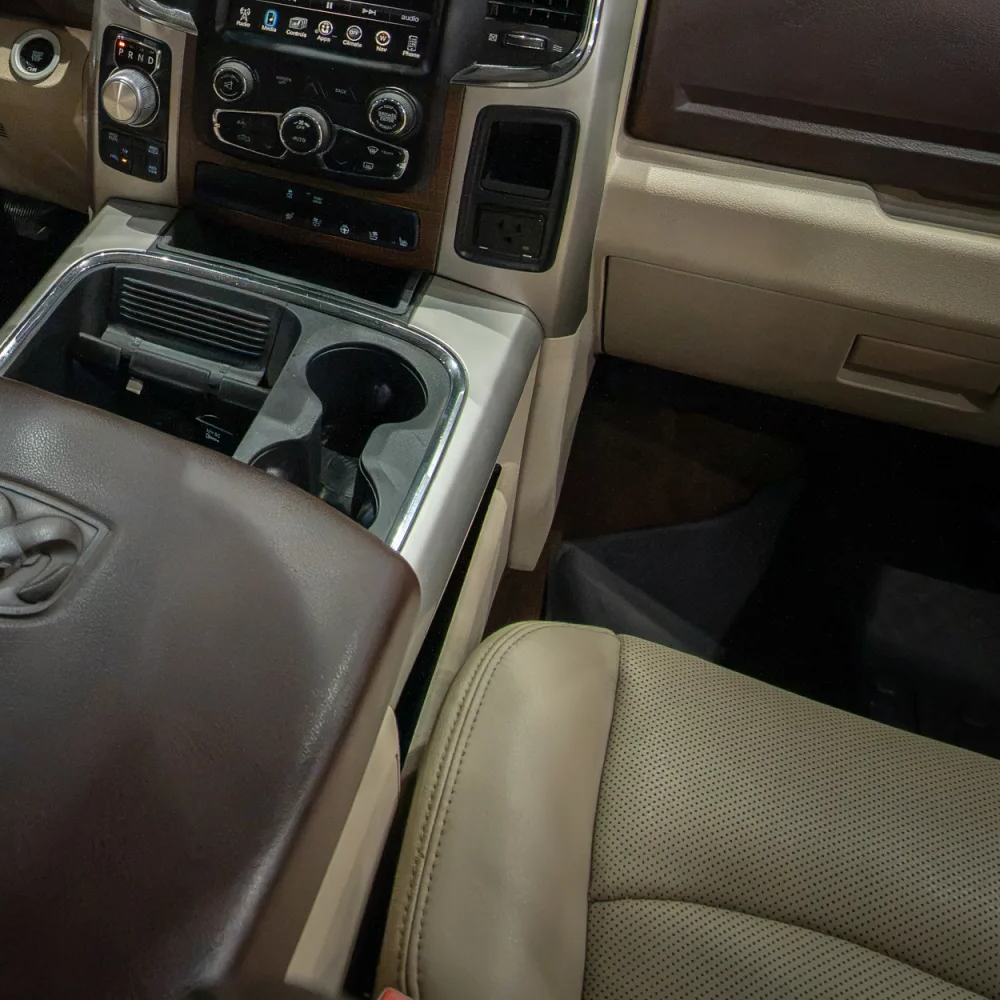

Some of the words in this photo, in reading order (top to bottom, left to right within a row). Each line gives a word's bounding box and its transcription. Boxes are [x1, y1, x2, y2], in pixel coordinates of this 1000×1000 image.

[400, 13, 419, 23] audio
[235, 20, 251, 28] Radio
[261, 24, 277, 33] Media
[285, 29, 308, 38] Controls
[316, 34, 331, 43] Apps
[342, 39, 363, 48] Climate
[375, 45, 387, 53] Nav
[118, 47, 124, 56] P
[127, 51, 133, 60] R
[137, 53, 144, 62] N
[147, 56, 154, 65] D
[401, 50, 421, 59] Phone
